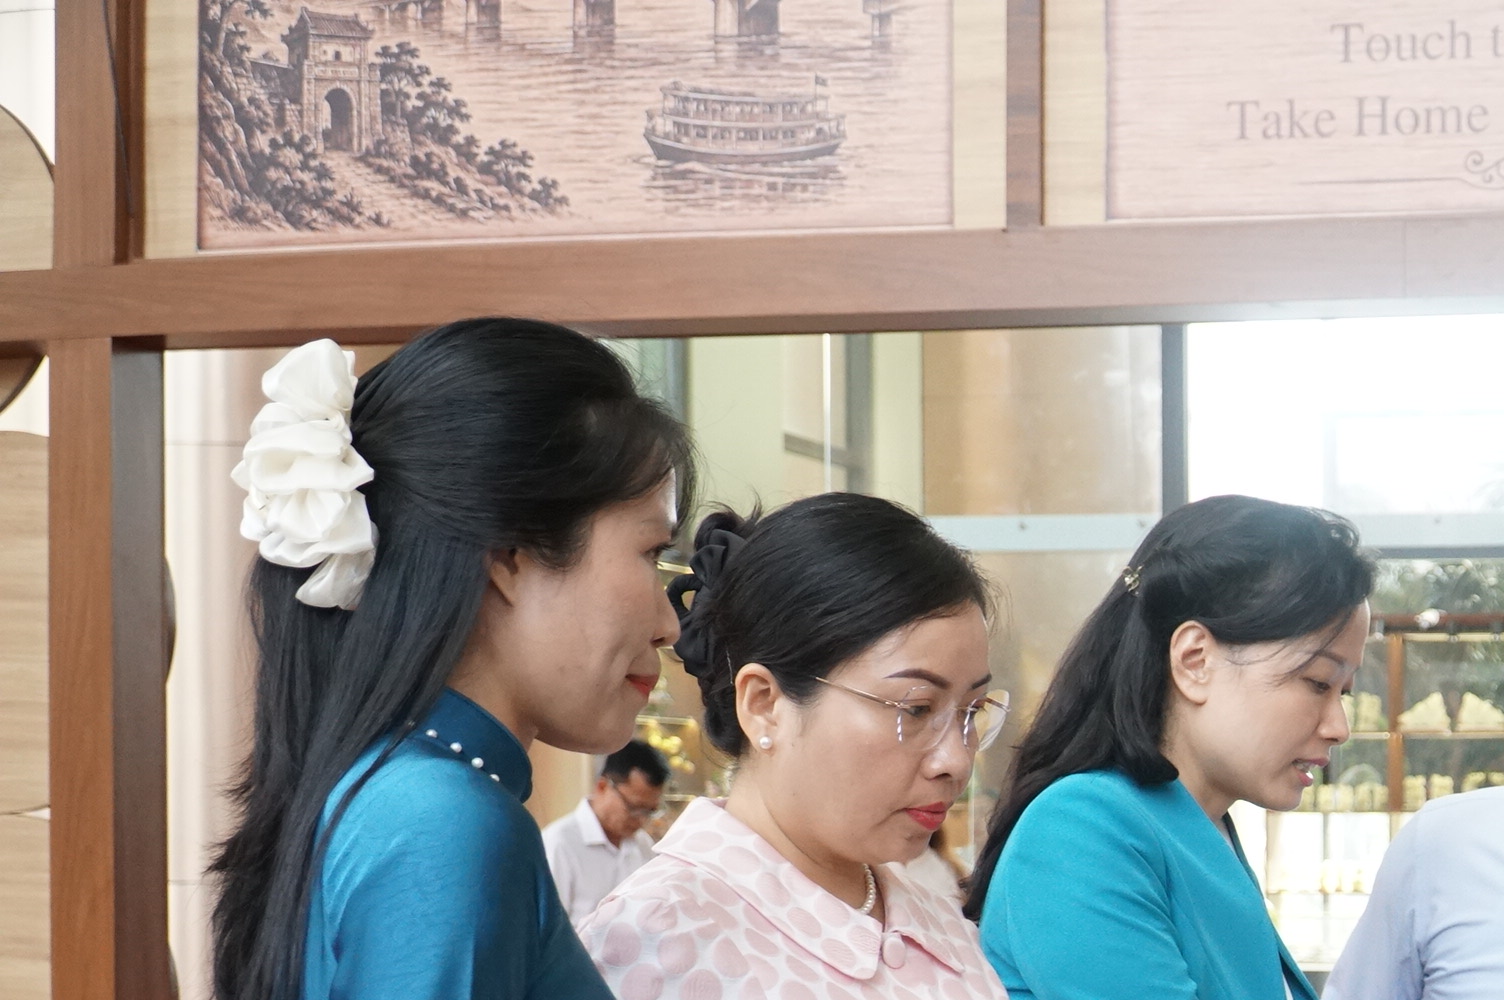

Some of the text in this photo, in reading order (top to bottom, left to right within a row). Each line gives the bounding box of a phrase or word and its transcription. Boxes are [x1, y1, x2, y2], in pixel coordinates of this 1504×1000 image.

[1330, 19, 1474, 65] Touch
[1226, 98, 1337, 141] Take
[1353, 93, 1491, 138] Home
